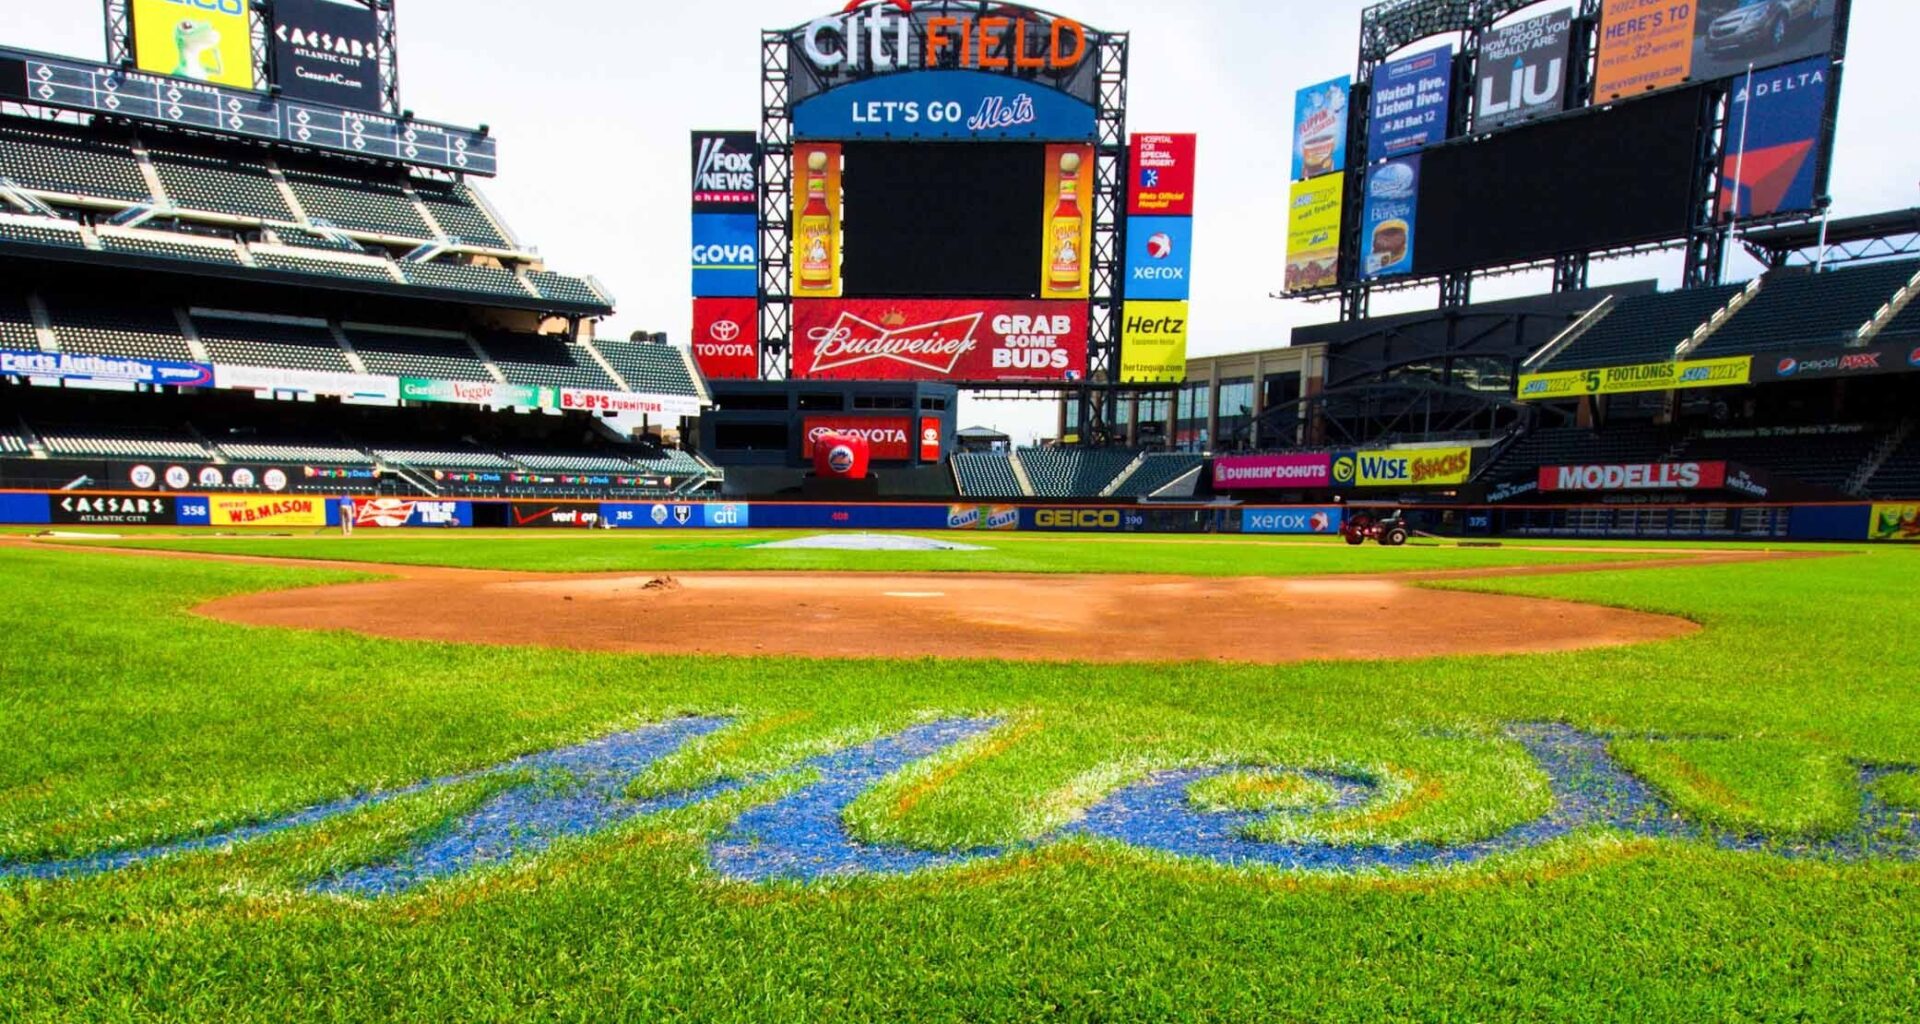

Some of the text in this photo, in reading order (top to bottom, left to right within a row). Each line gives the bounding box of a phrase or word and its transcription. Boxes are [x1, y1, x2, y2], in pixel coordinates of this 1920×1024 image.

[1500, 15, 1552, 39] FIND OUT
[1605, 11, 1663, 39] HERE'S
[1669, 4, 1689, 24] TO
[275, 25, 377, 59] CAESARS
[925, 16, 1087, 68] FIELD
[1480, 20, 1571, 54] HOW GOOD YOU
[1489, 34, 1559, 60] REALLY ARE.
[294, 48, 361, 67] ATLANTIC CITY
[1376, 77, 1446, 103] Watch live.
[1480, 57, 1562, 118] LIU
[1756, 70, 1823, 97] DELTA
[852, 94, 1034, 130] LET'S GO Mets
[1375, 92, 1444, 119] Listen live.
[1392, 110, 1436, 131] At Bat 12
[1140, 151, 1172, 159] SPECIAL
[1141, 143, 1155, 151] FOR
[713, 152, 753, 172] FOX
[1140, 159, 1176, 167] SURGERY
[703, 173, 754, 191] NEWS
[695, 193, 755, 201] channel
[693, 245, 754, 264] GOYA
[1133, 266, 1183, 279] xerox
[991, 314, 1071, 335] GRAB
[1126, 316, 1184, 334] Hertz
[696, 344, 753, 356] TOYOTA
[807, 326, 977, 356] Budweiser
[1004, 335, 1057, 348] SOME
[991, 348, 1070, 369] BUDS
[1799, 352, 1881, 372] pepsi MAX
[1123, 363, 1182, 373] hertzequip.com
[1607, 364, 1674, 382] FOOTLONGS
[1680, 362, 1748, 382] SUBWAY
[1522, 375, 1579, 394] SUBWAY
[1580, 370, 1600, 392] $5
[453, 382, 493, 400] Veggie
[612, 400, 661, 412] FURNITURE
[171, 471, 184, 482] 14
[205, 471, 217, 482] 41
[1360, 452, 1467, 483] WISE SNACKS
[1558, 463, 1700, 489] MODELL'S
[136, 471, 150, 483] 37
[1510, 481, 1537, 495] Zone
[61, 497, 164, 513] CAESARS
[182, 505, 206, 516] 358
[80, 514, 124, 522] ATLANTIC
[552, 510, 597, 523] verizon
[616, 510, 633, 521] 385
[714, 510, 738, 524] citi
[950, 510, 979, 526] Gulf
[988, 511, 1016, 527] Gulf
[1035, 509, 1120, 527] GEICO
[1125, 516, 1143, 525] 390
[1251, 513, 1305, 529] xerox
[1469, 516, 1487, 527] 375
